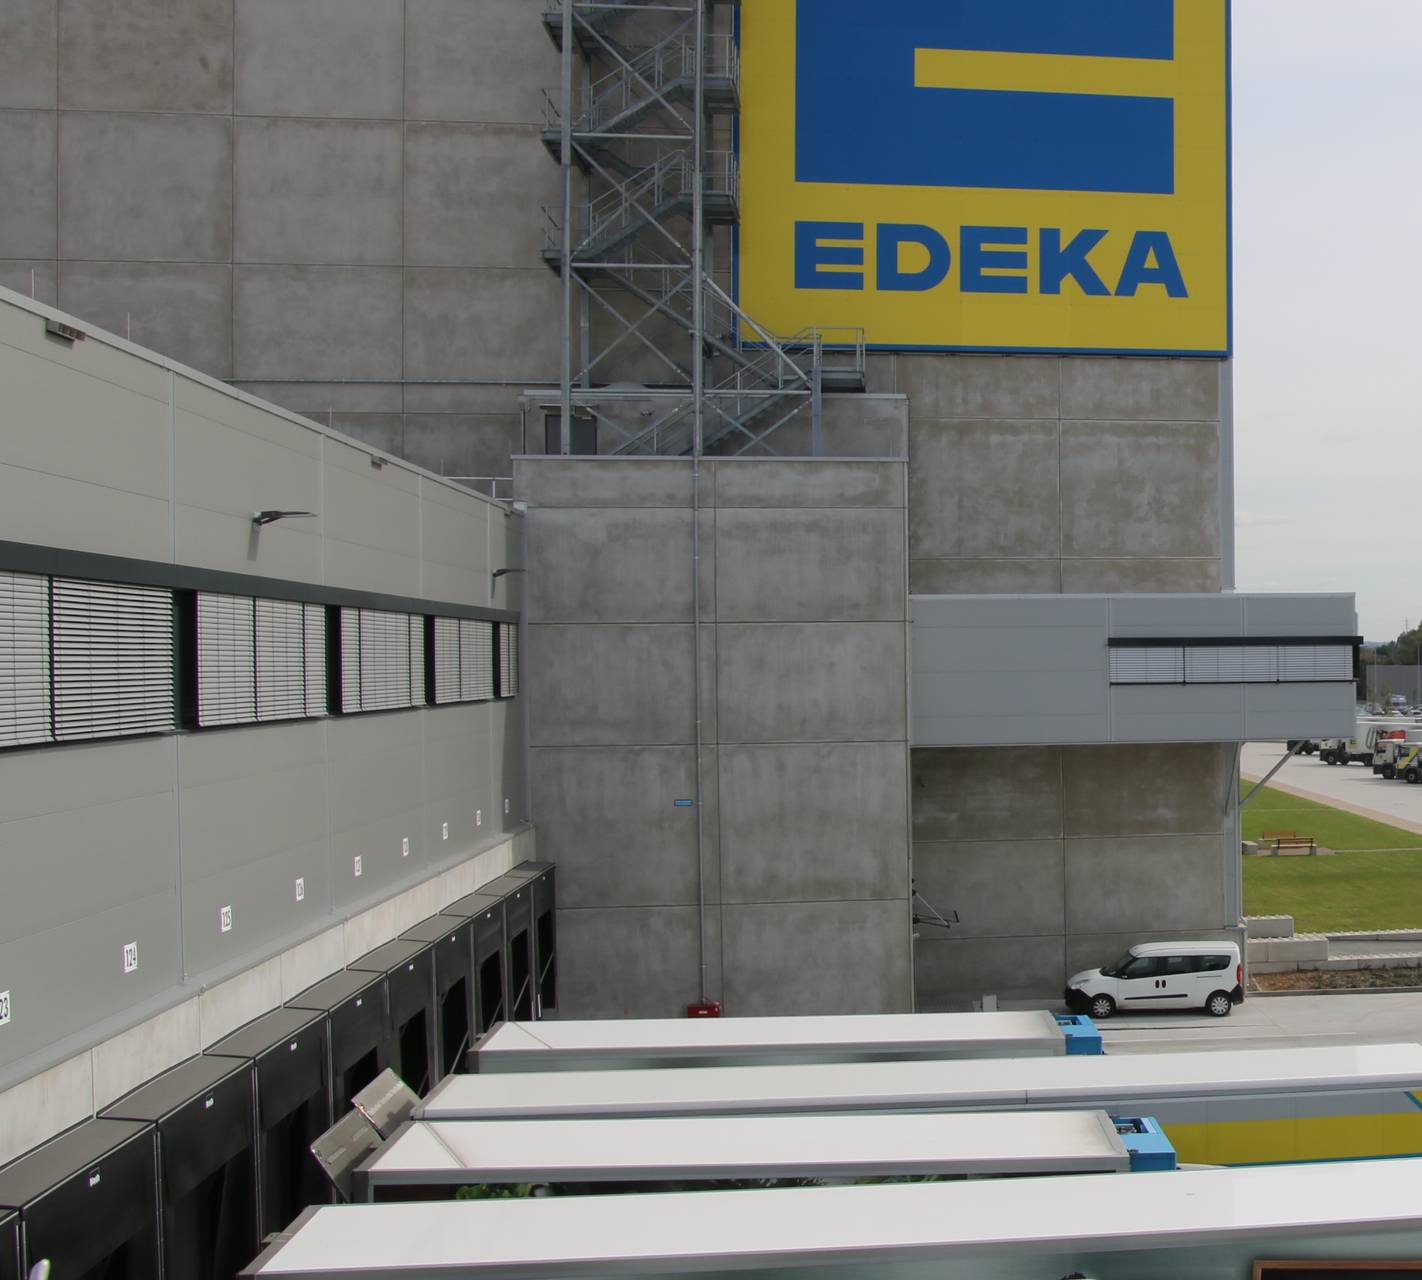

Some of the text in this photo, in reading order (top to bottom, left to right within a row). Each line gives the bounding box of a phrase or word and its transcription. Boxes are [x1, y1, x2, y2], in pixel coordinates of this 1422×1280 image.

[795, 220, 1189, 298] EDEKA
[222, 910, 231, 927] 125
[125, 947, 137, 968] 124
[0, 997, 8, 1020] 23
